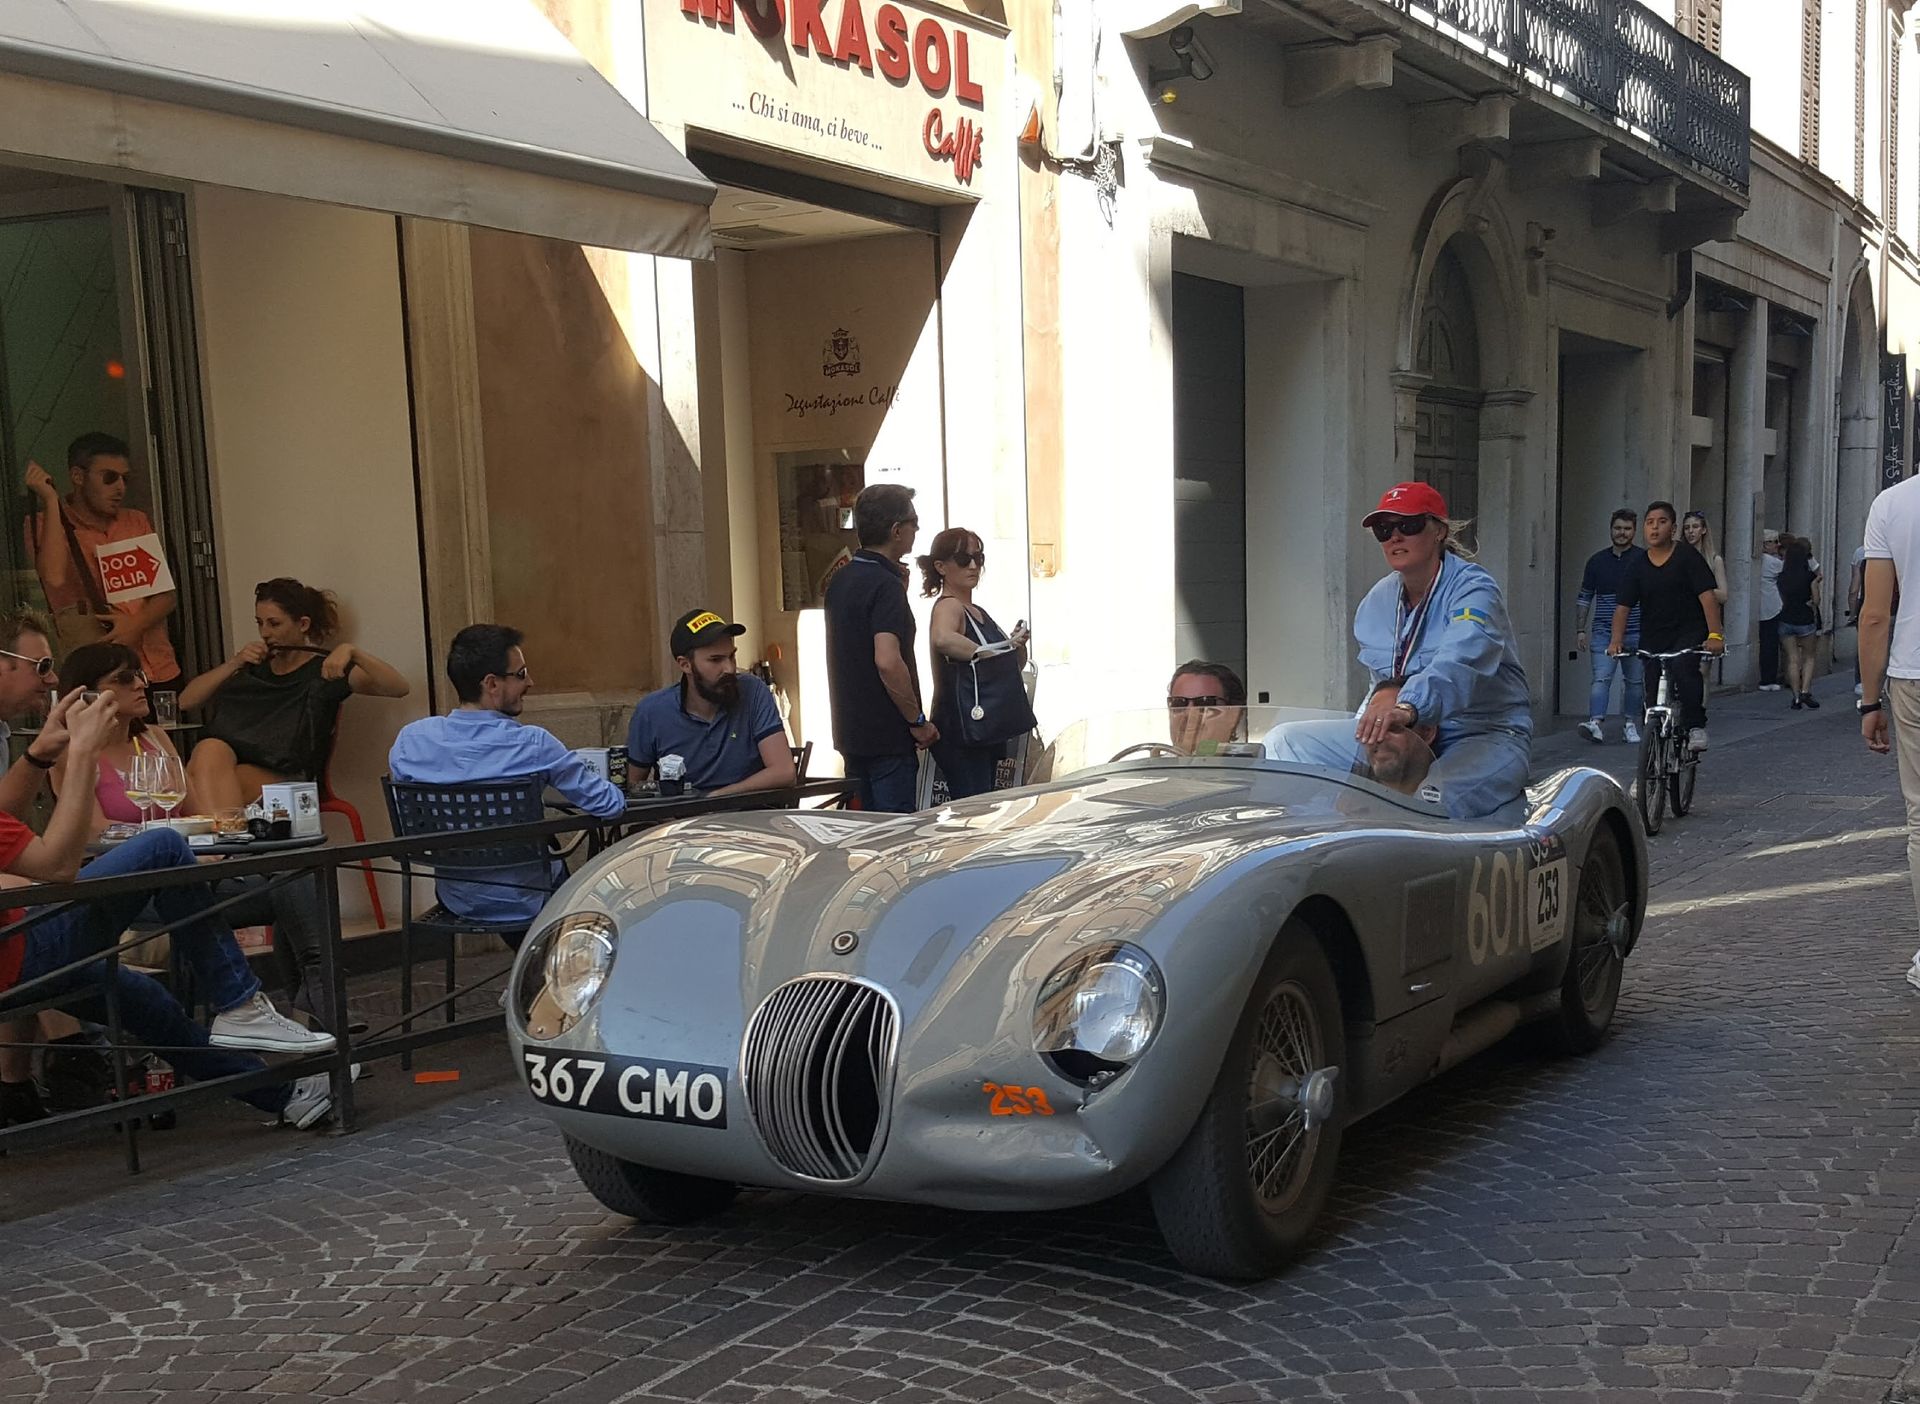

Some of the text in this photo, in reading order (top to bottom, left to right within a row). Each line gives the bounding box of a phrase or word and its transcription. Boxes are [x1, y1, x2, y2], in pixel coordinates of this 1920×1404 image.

[680, 0, 984, 104] KASOL
[749, 92, 774, 118] Chi
[778, 103, 789, 122] si
[792, 111, 824, 137] ama,
[827, 117, 837, 136] ci
[840, 119, 868, 145] beve
[1467, 847, 1525, 966] 601
[1537, 867, 1559, 925] 253
[525, 1053, 723, 1121] 367 GMO
